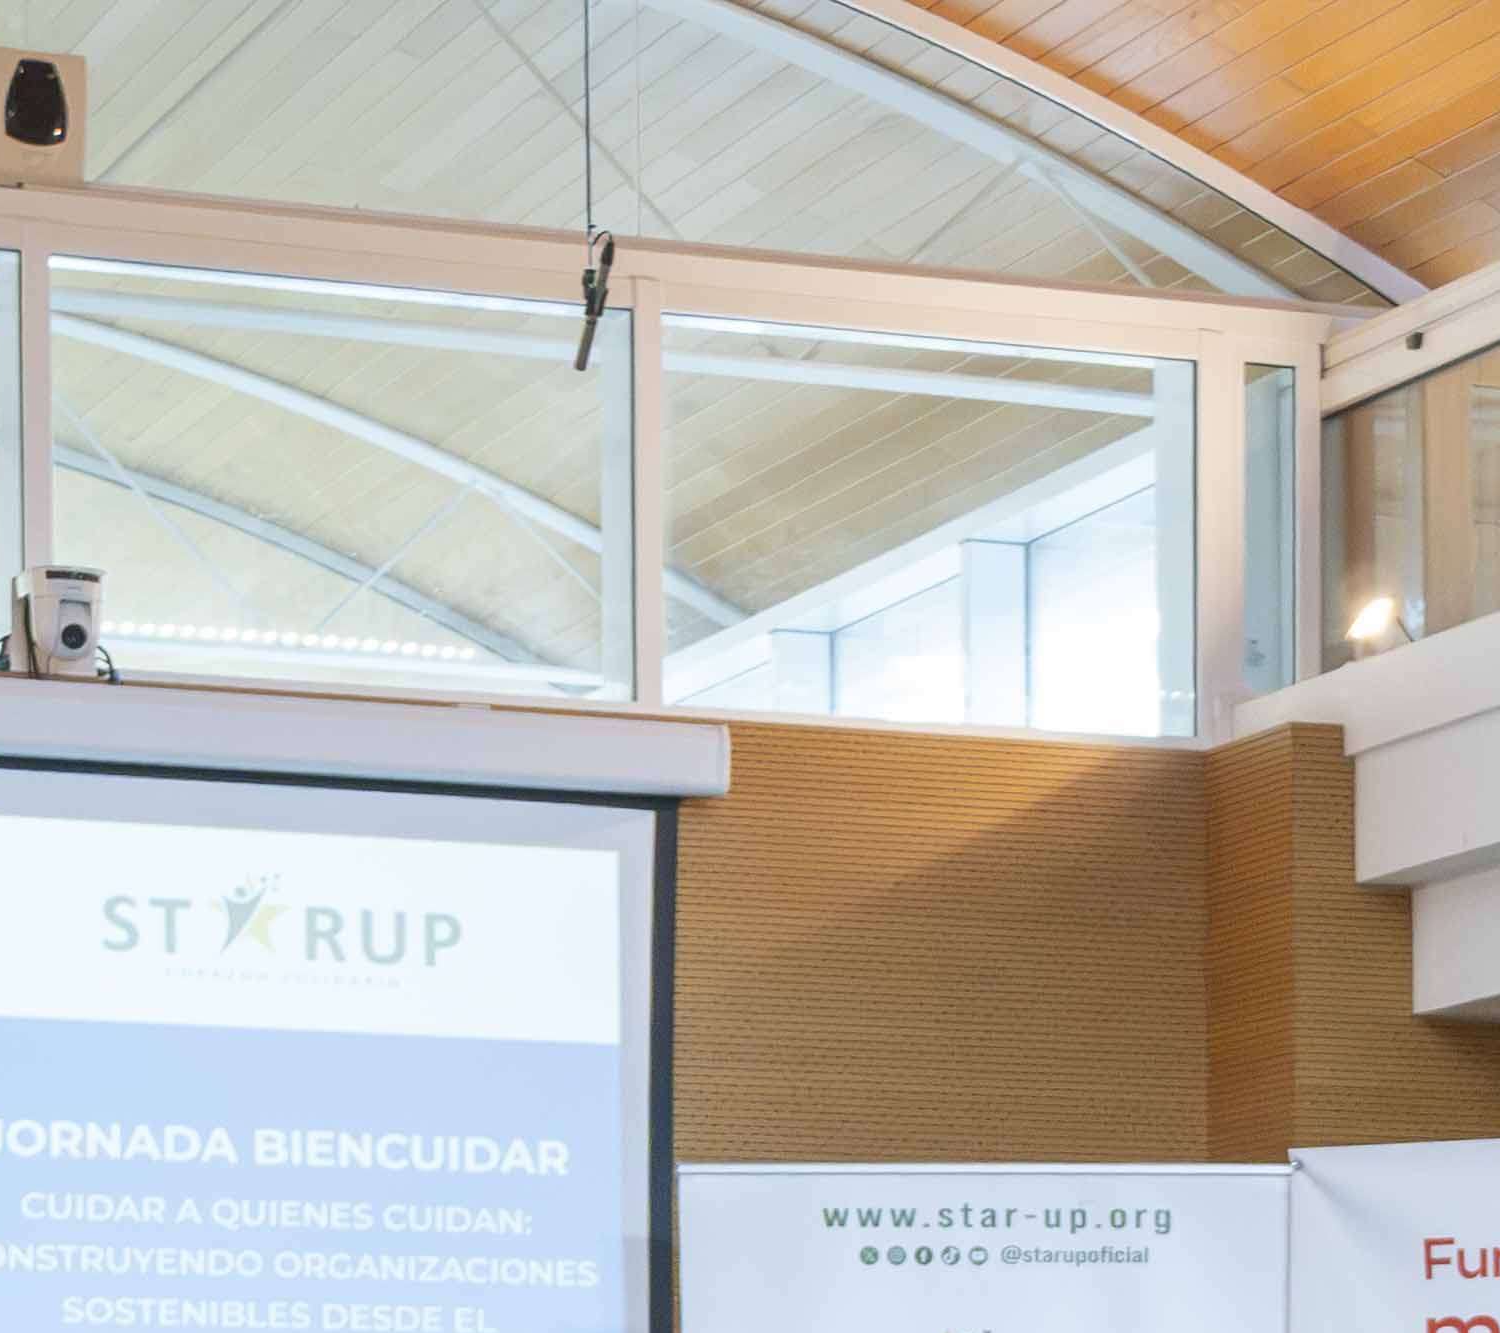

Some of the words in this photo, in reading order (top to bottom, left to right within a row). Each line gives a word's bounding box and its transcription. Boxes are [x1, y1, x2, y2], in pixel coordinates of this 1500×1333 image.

[253, 1128, 571, 1175] BIENCUIDAR
[20, 1191, 165, 1225] CUIDAR
[176, 1196, 202, 1225] A
[211, 1198, 374, 1231] QUIENES
[381, 1204, 533, 1236] CUIDAN:
[821, 1203, 1173, 1235] www.star-up.org
[273, 1251, 599, 1289] ORGANIZACIONES
[999, 1246, 1149, 1267] @starupoficial
[61, 1296, 311, 1331] SOSTENIBLES
[322, 1304, 443, 1333] DESDE
